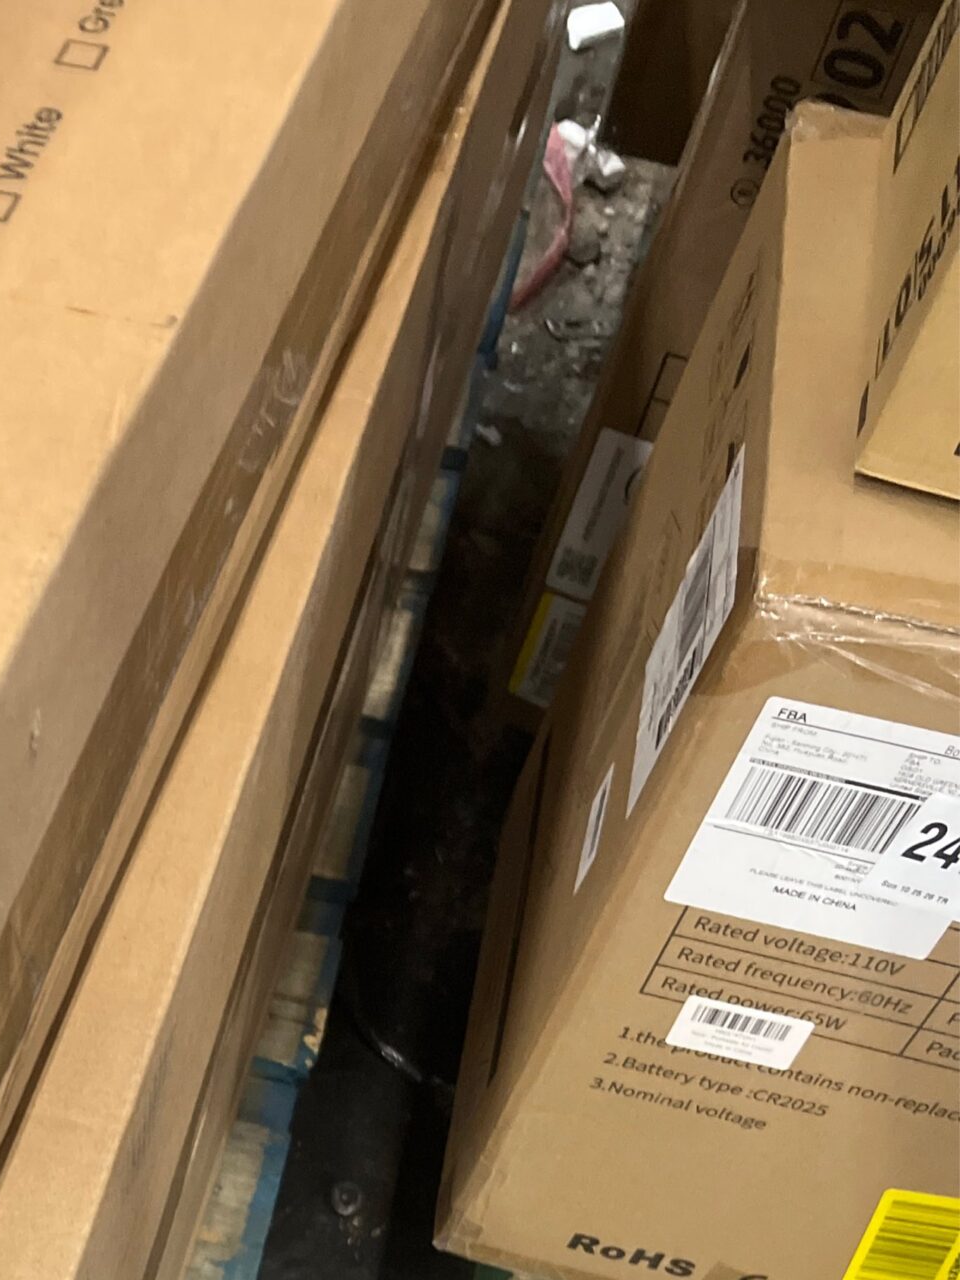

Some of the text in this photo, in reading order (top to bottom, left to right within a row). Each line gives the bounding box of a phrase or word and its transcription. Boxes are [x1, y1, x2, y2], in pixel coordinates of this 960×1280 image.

[777, 708, 807, 723] FBA
[772, 885, 856, 911] MADE IN CHINA
[694, 916, 906, 976] Rated voltage:110V
[660, 976, 723, 1001] Rated
[677, 946, 913, 1015] Rated frequency:60Hz
[603, 1052, 693, 1086] 2.Battery
[698, 1075, 744, 1097] type
[618, 1026, 667, 1049] 1.the
[757, 1064, 844, 1092] contains
[847, 1085, 960, 1122] non-replac
[589, 1077, 767, 1130] 3.Nominal voltage
[566, 1233, 695, 1278] RoHS
